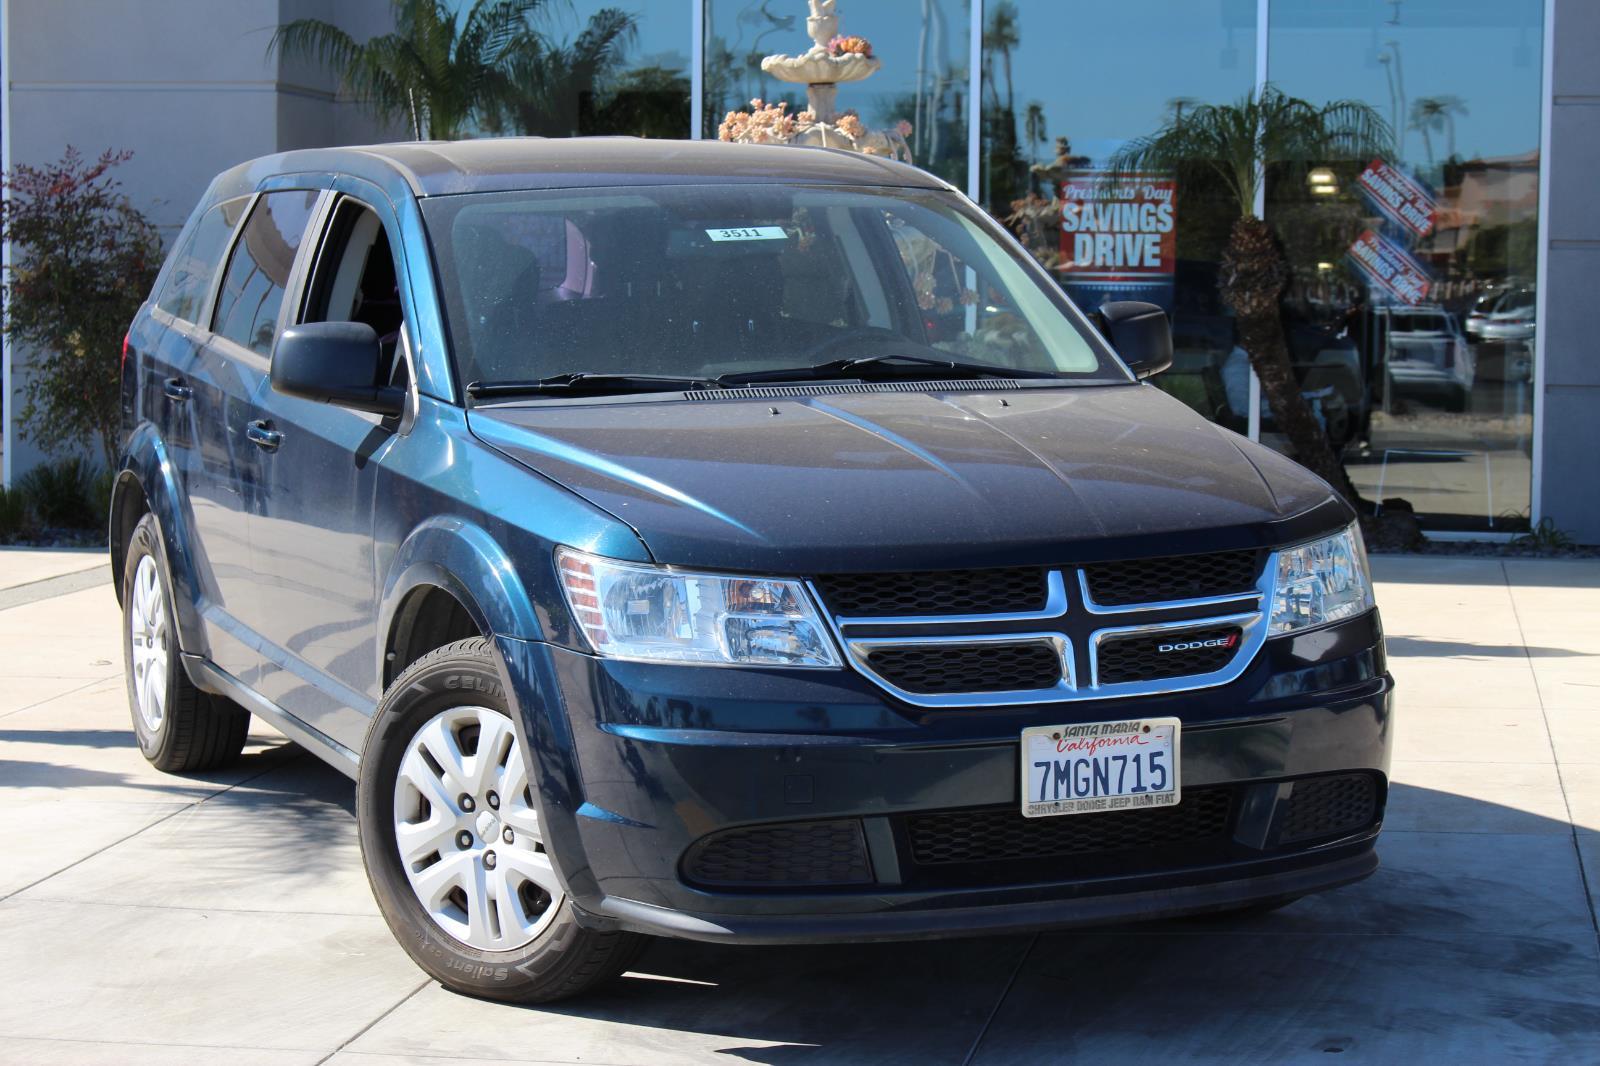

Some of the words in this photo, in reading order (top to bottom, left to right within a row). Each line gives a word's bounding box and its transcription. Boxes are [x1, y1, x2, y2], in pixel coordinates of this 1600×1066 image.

[1142, 185, 1173, 203] Day
[1361, 168, 1404, 208] SAVINGS
[1400, 202, 1433, 233] DRIVE
[1061, 202, 1174, 233] SAVINGS
[720, 228, 763, 238] 3511
[1073, 233, 1161, 267] DRIVE
[1351, 240, 1395, 280] SAVINGS
[1391, 274, 1422, 304] DRIVE
[1158, 638, 1229, 652] DODGE
[1063, 724, 1099, 738] SANTA
[1101, 721, 1141, 735] MARIA
[1056, 734, 1149, 757] California
[1034, 750, 1167, 801] 7MGN715
[1028, 802, 1074, 815] CHRYSLER
[1077, 799, 1107, 812] DODGE
[1108, 797, 1131, 809] JEEP
[1133, 796, 1154, 806] RAM
[1156, 793, 1176, 804] FIAT
